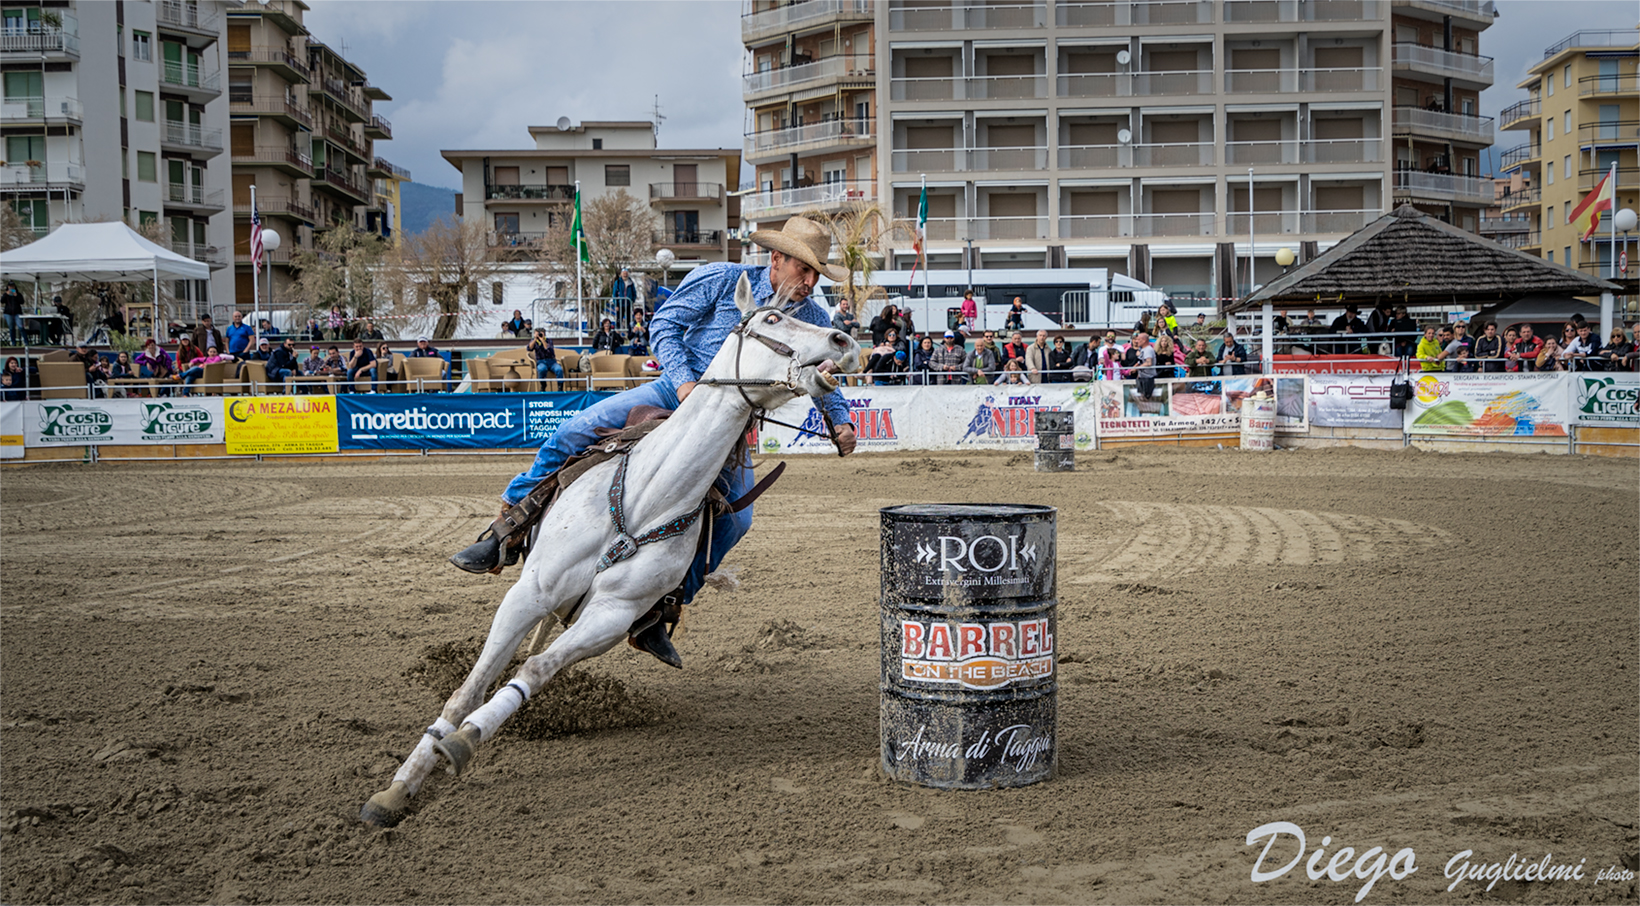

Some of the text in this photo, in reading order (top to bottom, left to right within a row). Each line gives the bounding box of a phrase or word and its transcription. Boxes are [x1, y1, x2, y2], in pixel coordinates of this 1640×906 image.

[247, 399, 331, 414] A MEZALÜNA
[847, 398, 872, 408] ALY
[1008, 396, 1042, 406] ITALY
[350, 406, 514, 435] moretticompact
[1100, 420, 1150, 429] TECNOTETTI
[937, 535, 1019, 572] ROI
[925, 575, 1030, 587] Extravergini Millesimati
[902, 620, 1054, 662] BARREL
[912, 662, 1048, 679] ON THE BEACH
[896, 724, 1050, 774] Arma di Taggia
